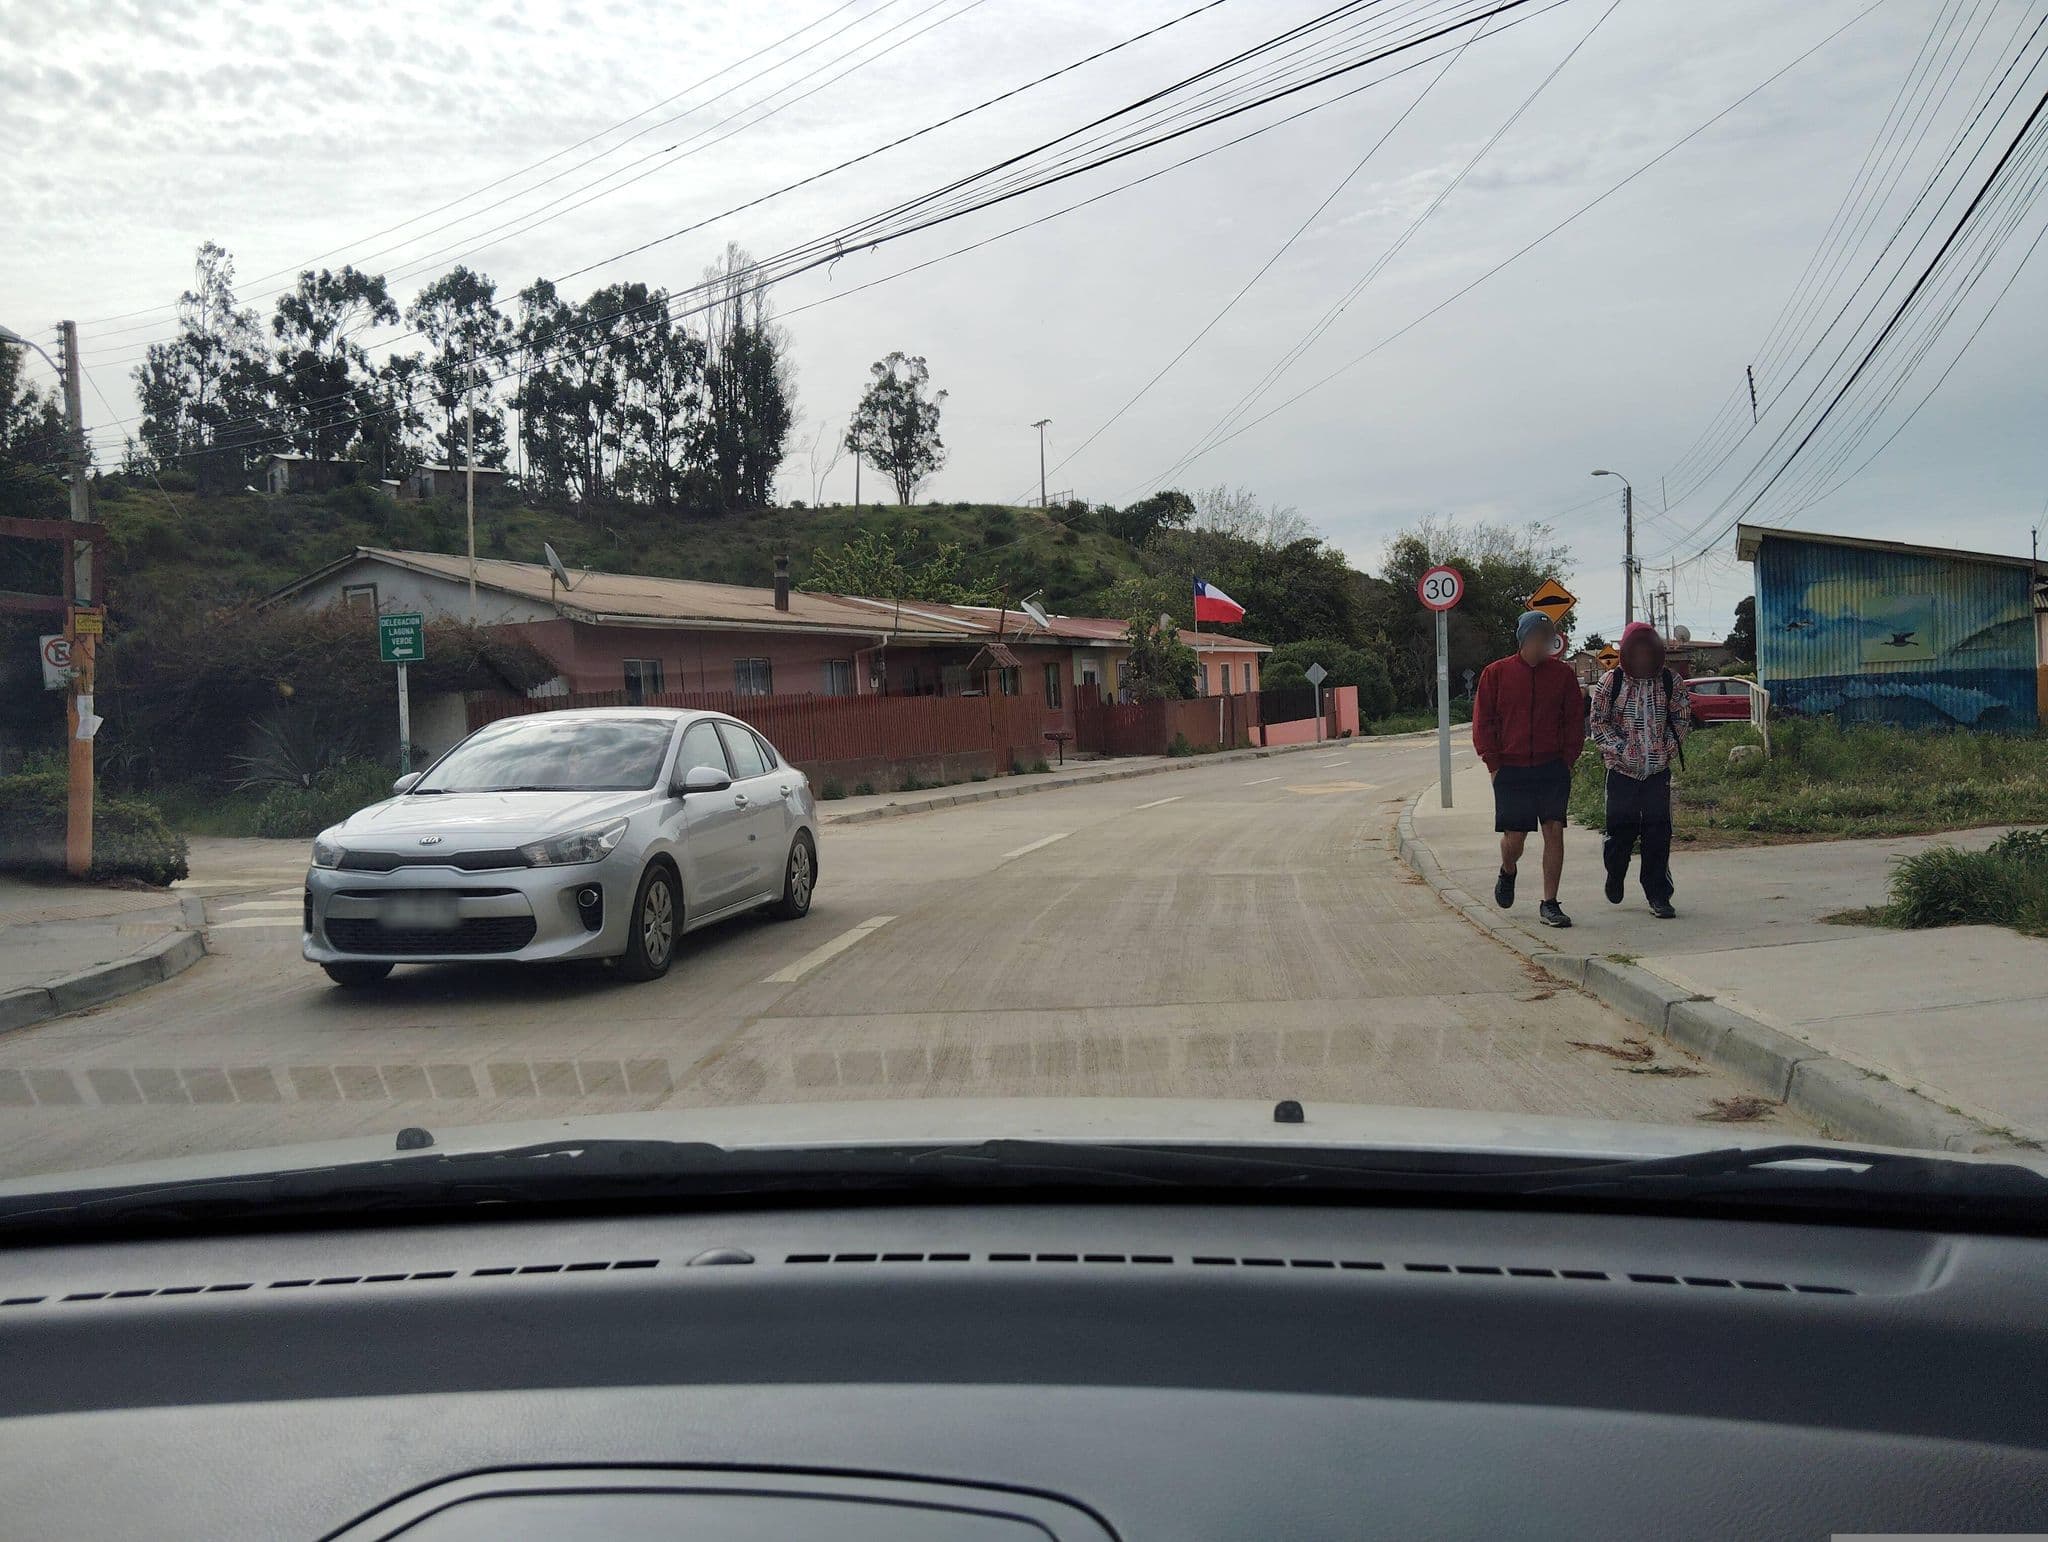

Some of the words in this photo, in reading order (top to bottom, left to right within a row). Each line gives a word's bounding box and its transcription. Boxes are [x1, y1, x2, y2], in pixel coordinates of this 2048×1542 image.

[1425, 577, 1455, 600] 30
[389, 627, 415, 636] LAGUNA
[391, 637, 414, 645] VERDE
[420, 835, 441, 844] KIA
